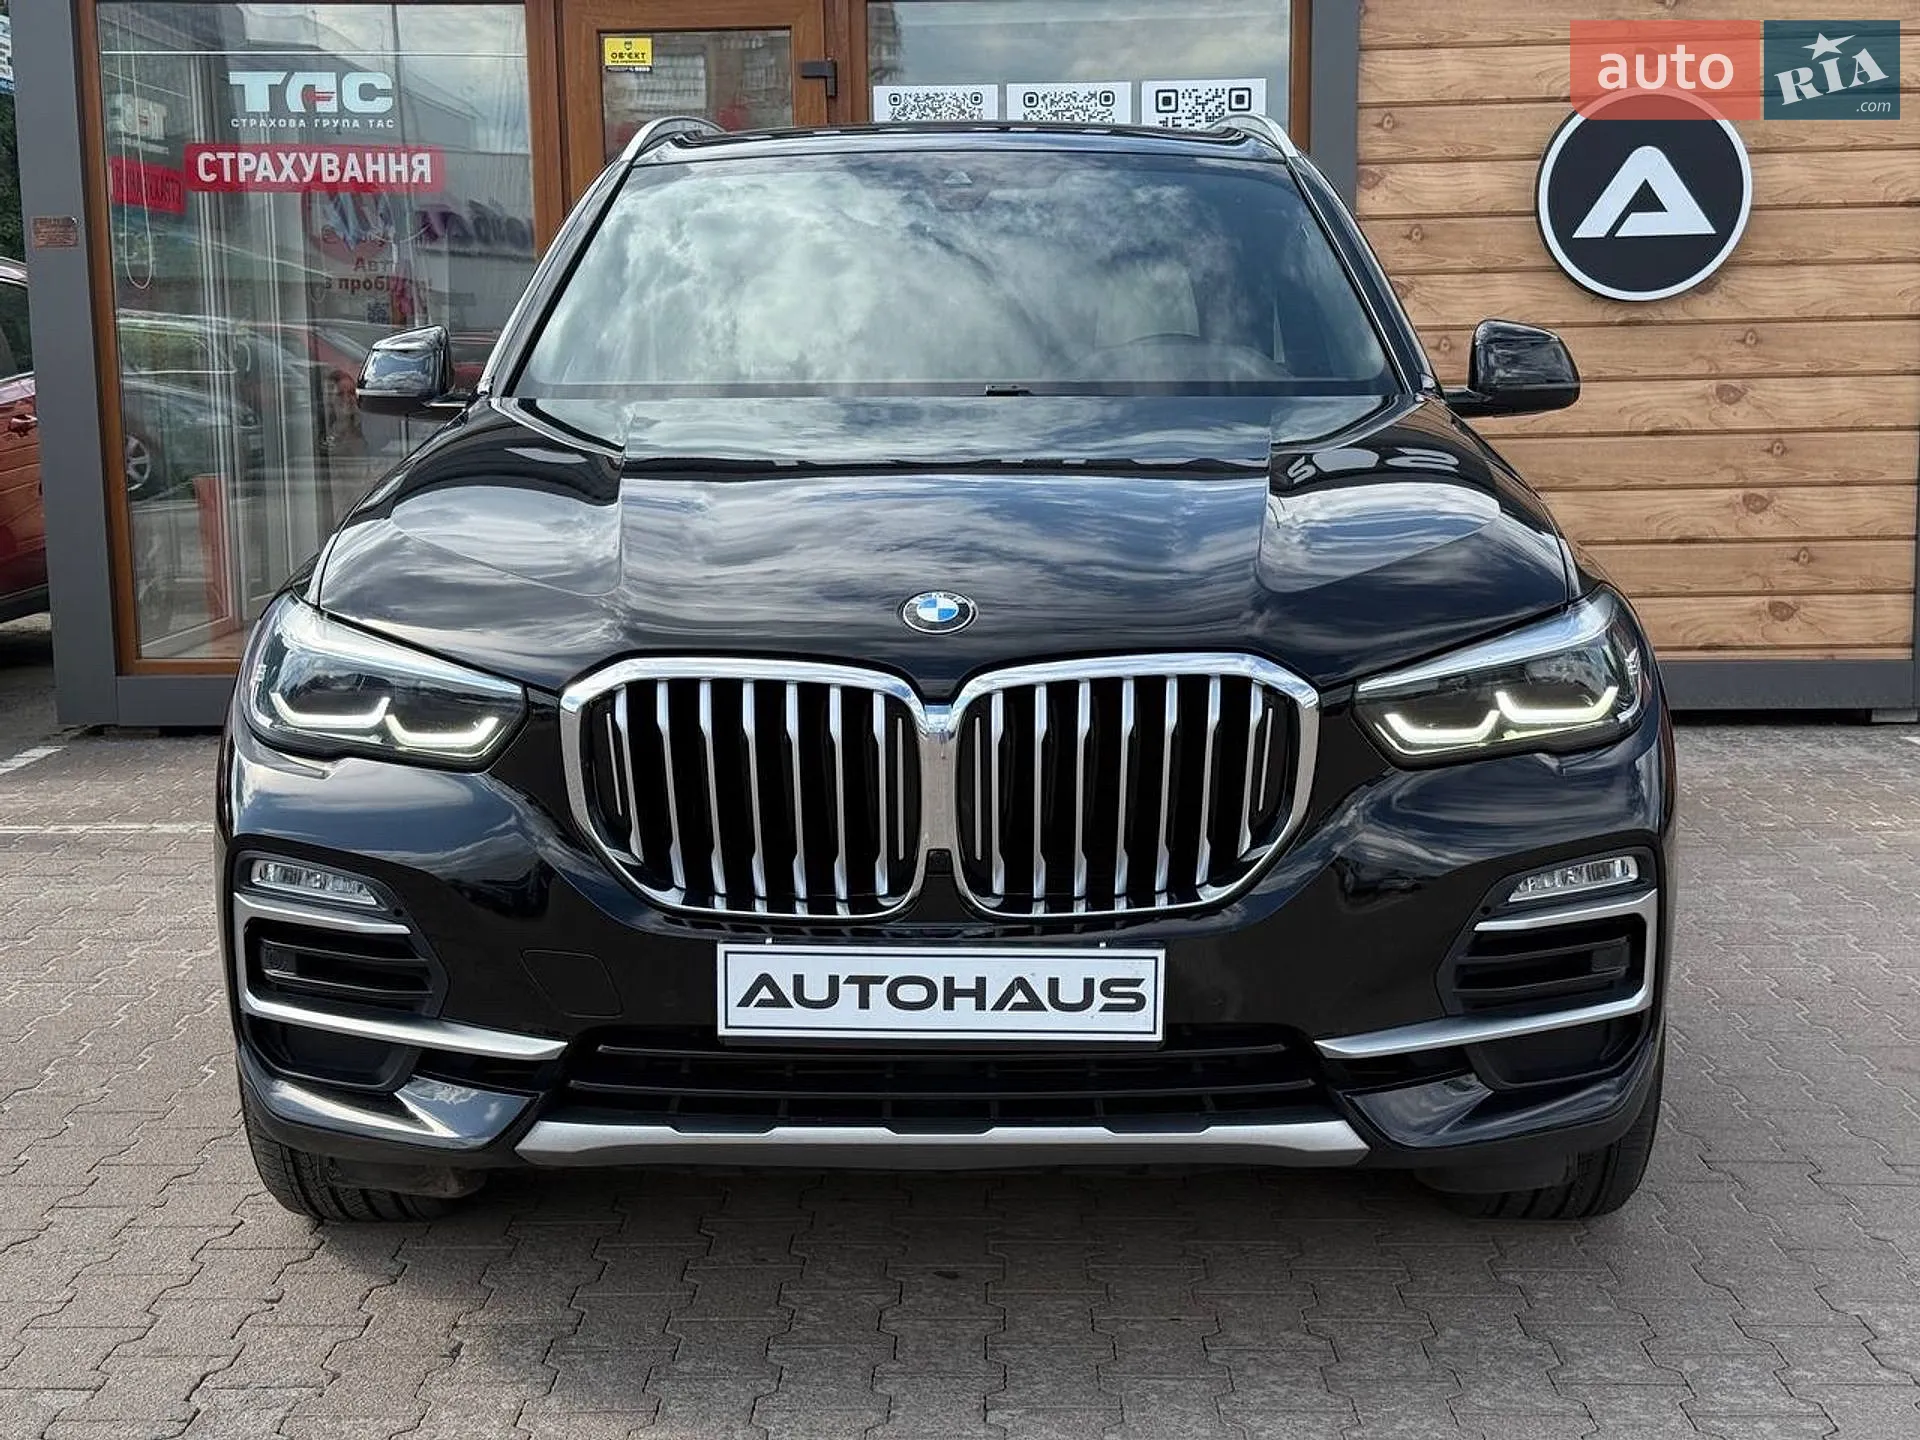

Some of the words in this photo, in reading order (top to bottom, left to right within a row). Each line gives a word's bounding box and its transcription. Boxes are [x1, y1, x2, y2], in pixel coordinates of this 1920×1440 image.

[230, 118, 306, 129] СТРАХОВА
[314, 118, 360, 129] ГРУПА
[368, 119, 395, 129] ТАС
[198, 152, 432, 184] СТРАХУВАННЯ
[735, 972, 1147, 1013] AUTOHAUS
